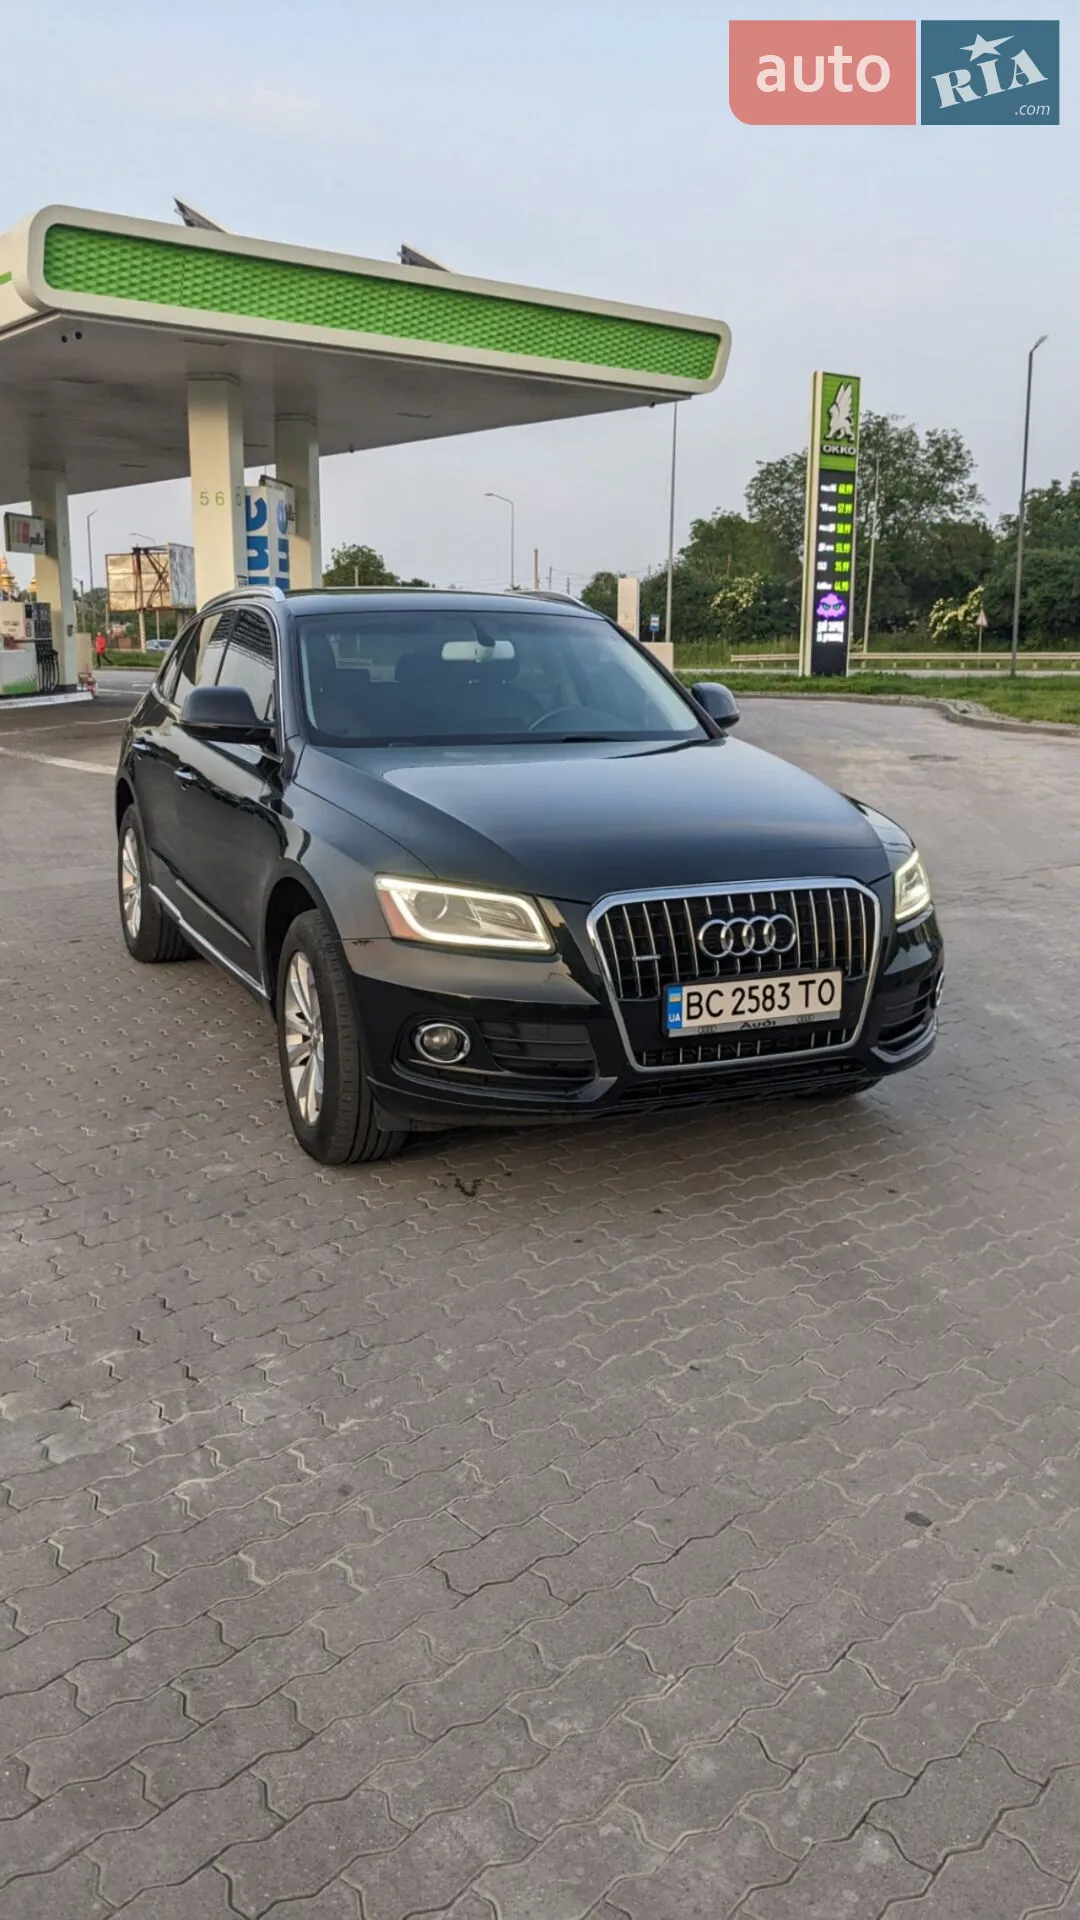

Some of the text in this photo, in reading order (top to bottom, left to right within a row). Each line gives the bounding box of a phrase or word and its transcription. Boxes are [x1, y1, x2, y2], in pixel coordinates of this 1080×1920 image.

[822, 444, 856, 455] OKKO
[199, 491, 209, 506] 5
[215, 491, 225, 506] 6
[686, 978, 835, 1020] BC 2583 TO
[669, 1013, 681, 1023] UA
[740, 1019, 776, 1030] Audi
